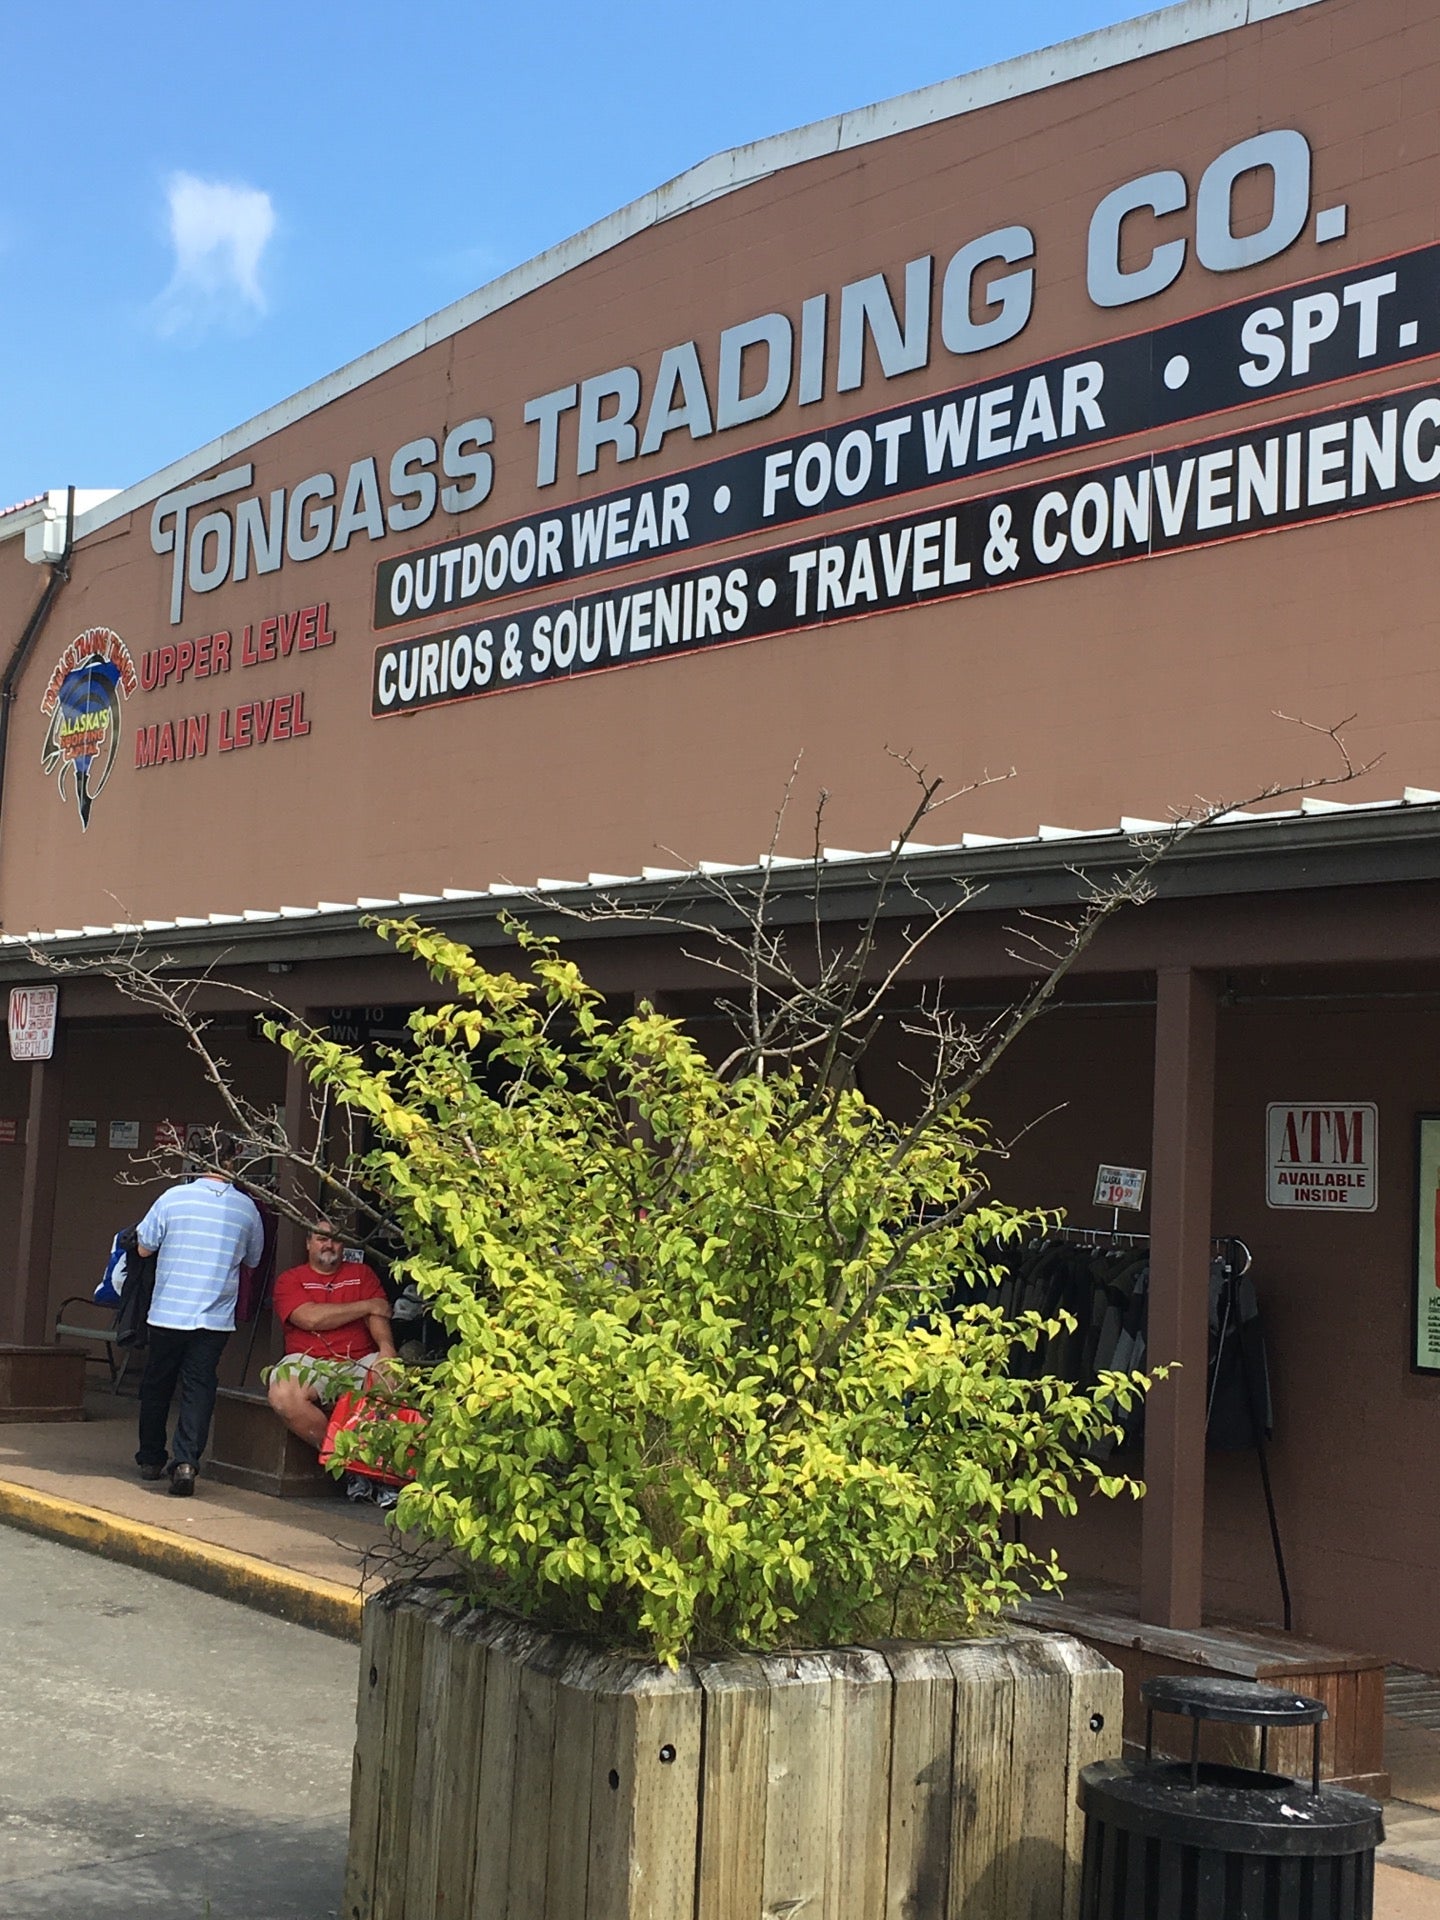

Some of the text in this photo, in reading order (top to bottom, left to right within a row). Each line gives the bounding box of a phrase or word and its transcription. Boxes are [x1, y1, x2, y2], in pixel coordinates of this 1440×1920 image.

[150, 129, 1347, 625] TONGASS TRADING CO.
[390, 518, 564, 617] OUTDOOR
[571, 482, 690, 569] WEAR
[1238, 271, 1418, 388] SPT.
[378, 397, 1440, 706] CURIOS & SOUVENIRS TRAVEL & CONVENIENC
[140, 602, 335, 691] UPPER LEVEL
[60, 708, 109, 737] ALASKA'S
[134, 682, 311, 769] MAIN LEVEL
[12, 991, 28, 1030] NO
[1277, 1110, 1366, 1164] ATM
[1277, 1172, 1366, 1188] AVAILABLE
[1294, 1188, 1348, 1203] INSIDE
